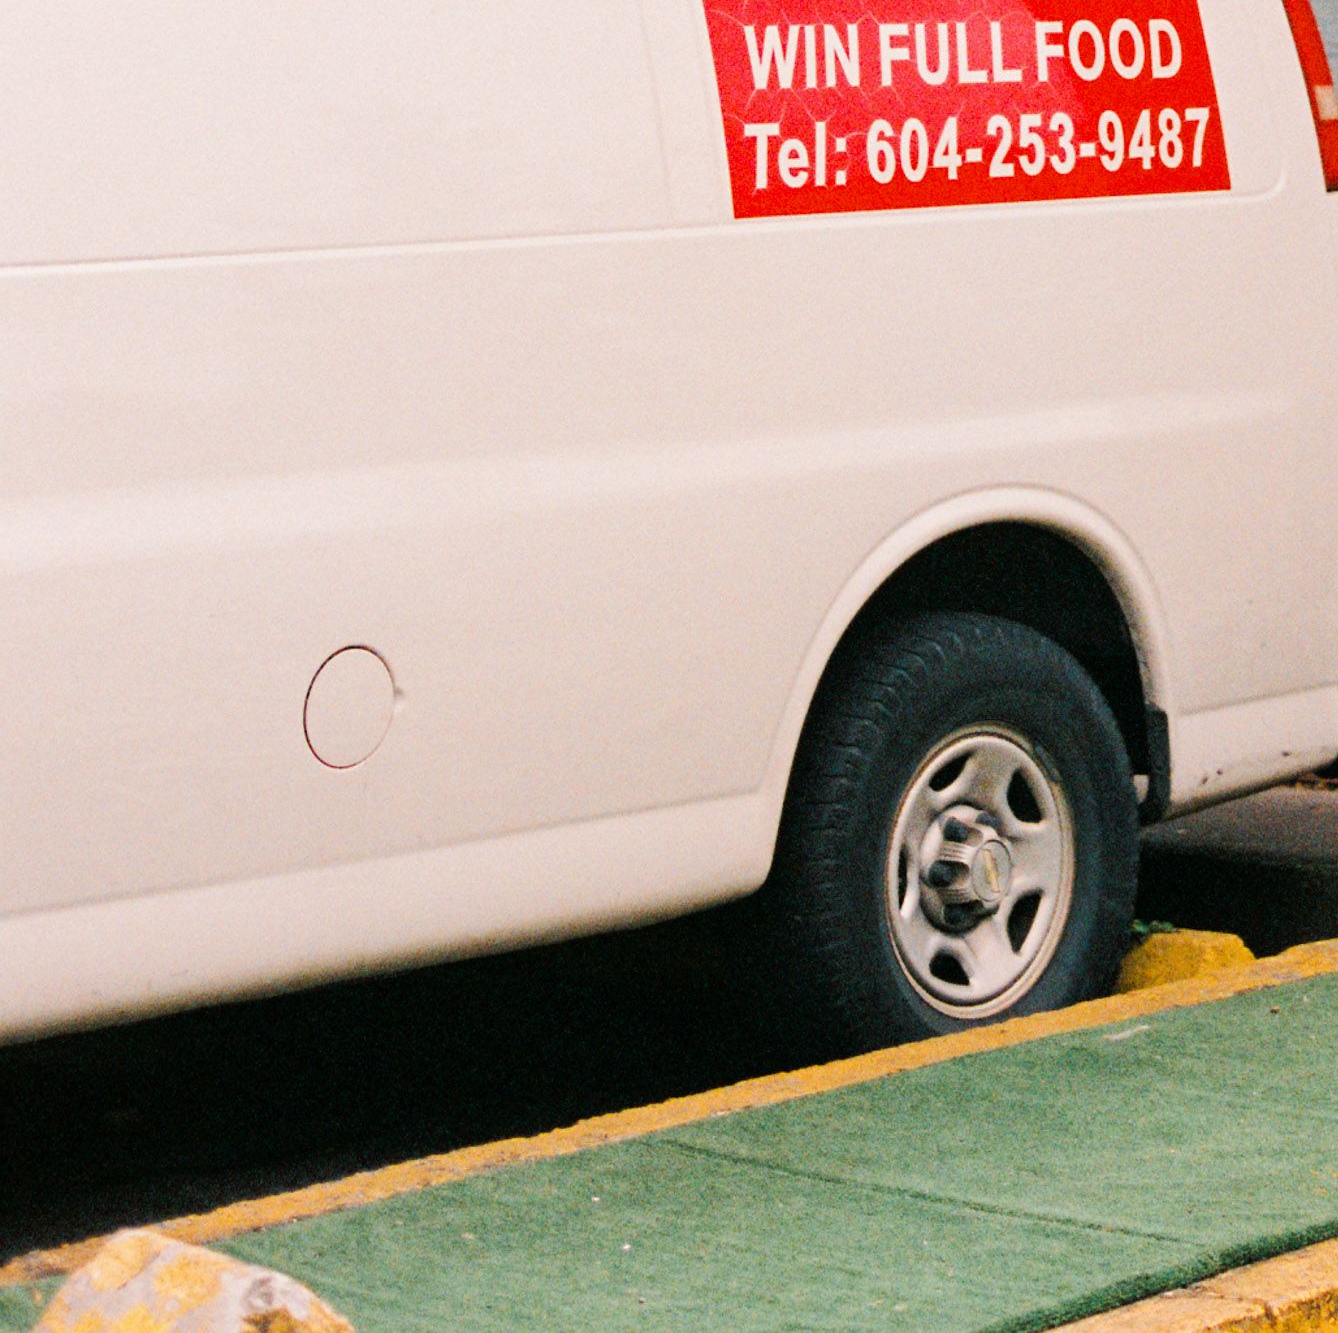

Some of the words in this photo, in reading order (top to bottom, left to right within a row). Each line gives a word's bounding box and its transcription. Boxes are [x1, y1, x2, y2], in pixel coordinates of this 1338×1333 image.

[743, 23, 861, 90] WIN
[878, 21, 1023, 88] FULL
[1034, 18, 1182, 82] FOOD
[744, 120, 849, 190] Tel:
[866, 107, 1210, 184] 604-253-9487
